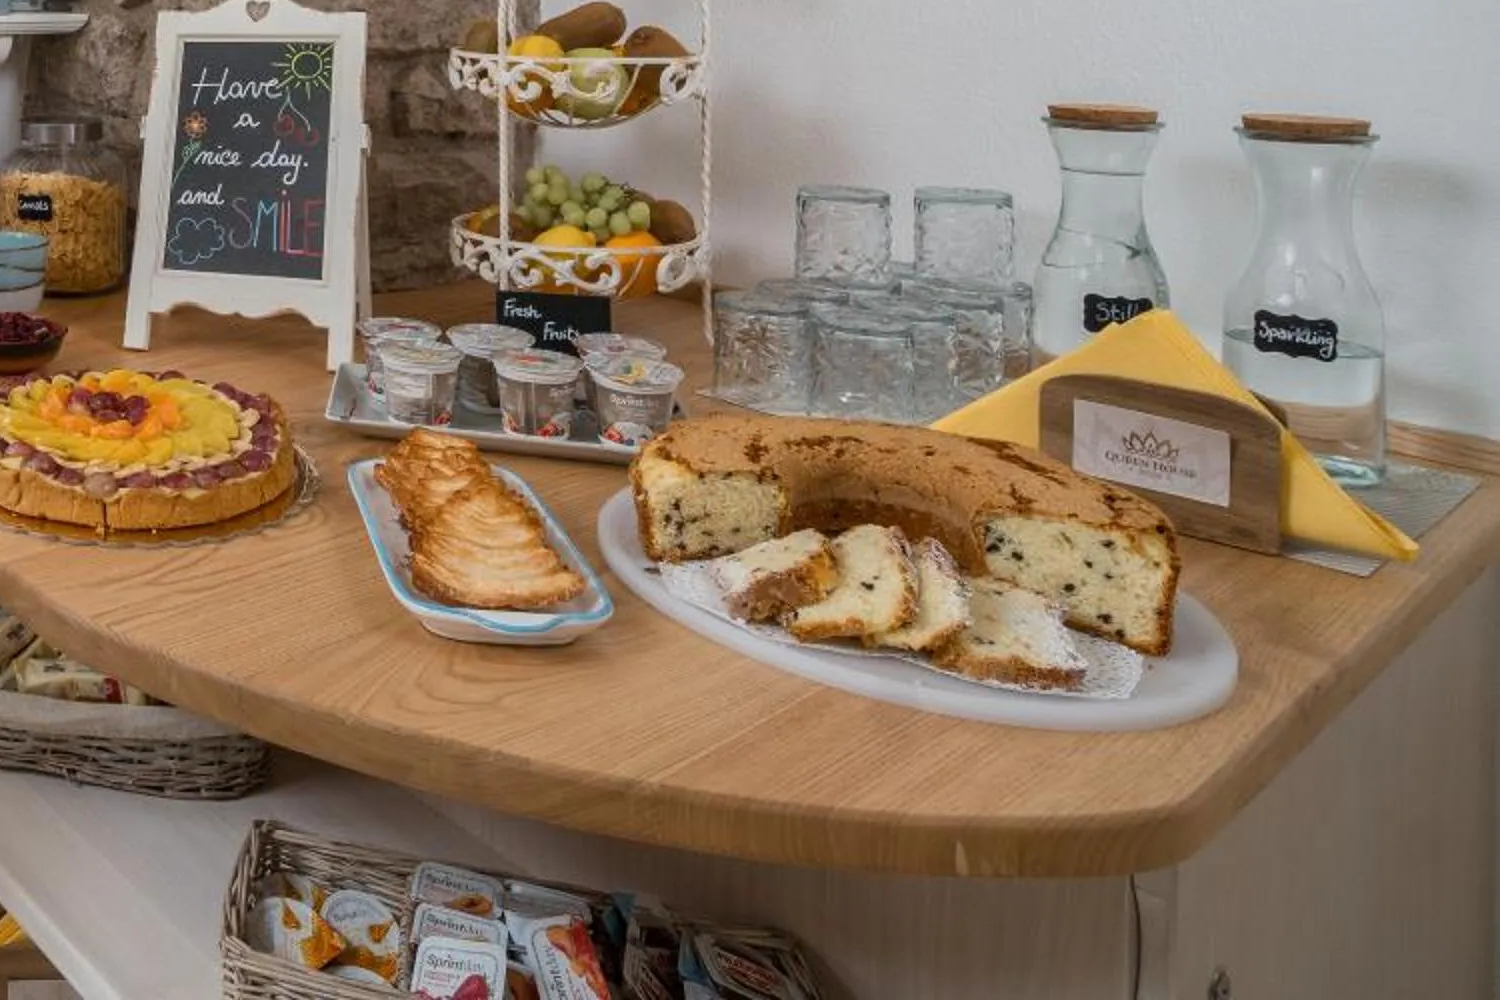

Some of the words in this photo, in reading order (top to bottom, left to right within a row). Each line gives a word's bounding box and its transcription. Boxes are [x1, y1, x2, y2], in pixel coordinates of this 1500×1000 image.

[192, 67, 281, 105] Have
[233, 112, 261, 128] a
[194, 145, 241, 166] nice
[178, 183, 225, 206] and
[503, 298, 542, 319] Fresh
